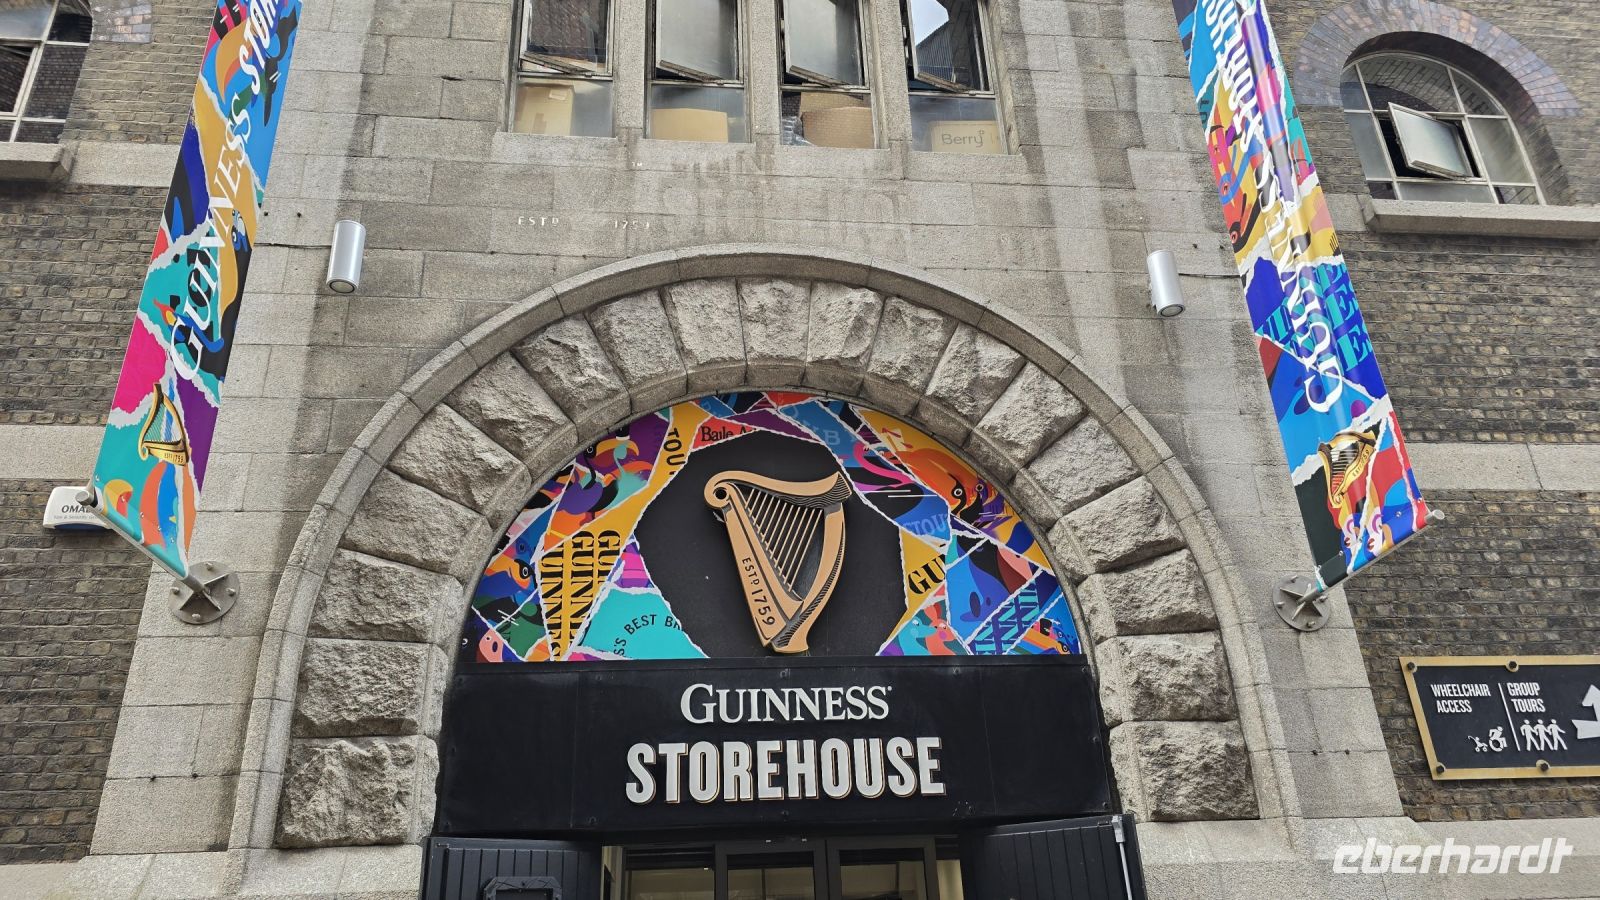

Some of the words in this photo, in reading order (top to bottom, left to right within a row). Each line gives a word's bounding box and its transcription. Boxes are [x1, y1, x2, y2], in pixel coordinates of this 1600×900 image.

[942, 130, 984, 148] Berry
[170, 92, 252, 380] GUINNESS
[751, 588, 775, 625] 1759
[623, 614, 657, 635] BEST
[1430, 683, 1491, 697] WHEELCHAIR
[1506, 682, 1541, 697] GROUP
[680, 683, 893, 724] GUINNESS
[1436, 700, 1473, 714] ACCESS
[1511, 698, 1546, 713] TOURS
[625, 736, 947, 804] STOREHOUSE
